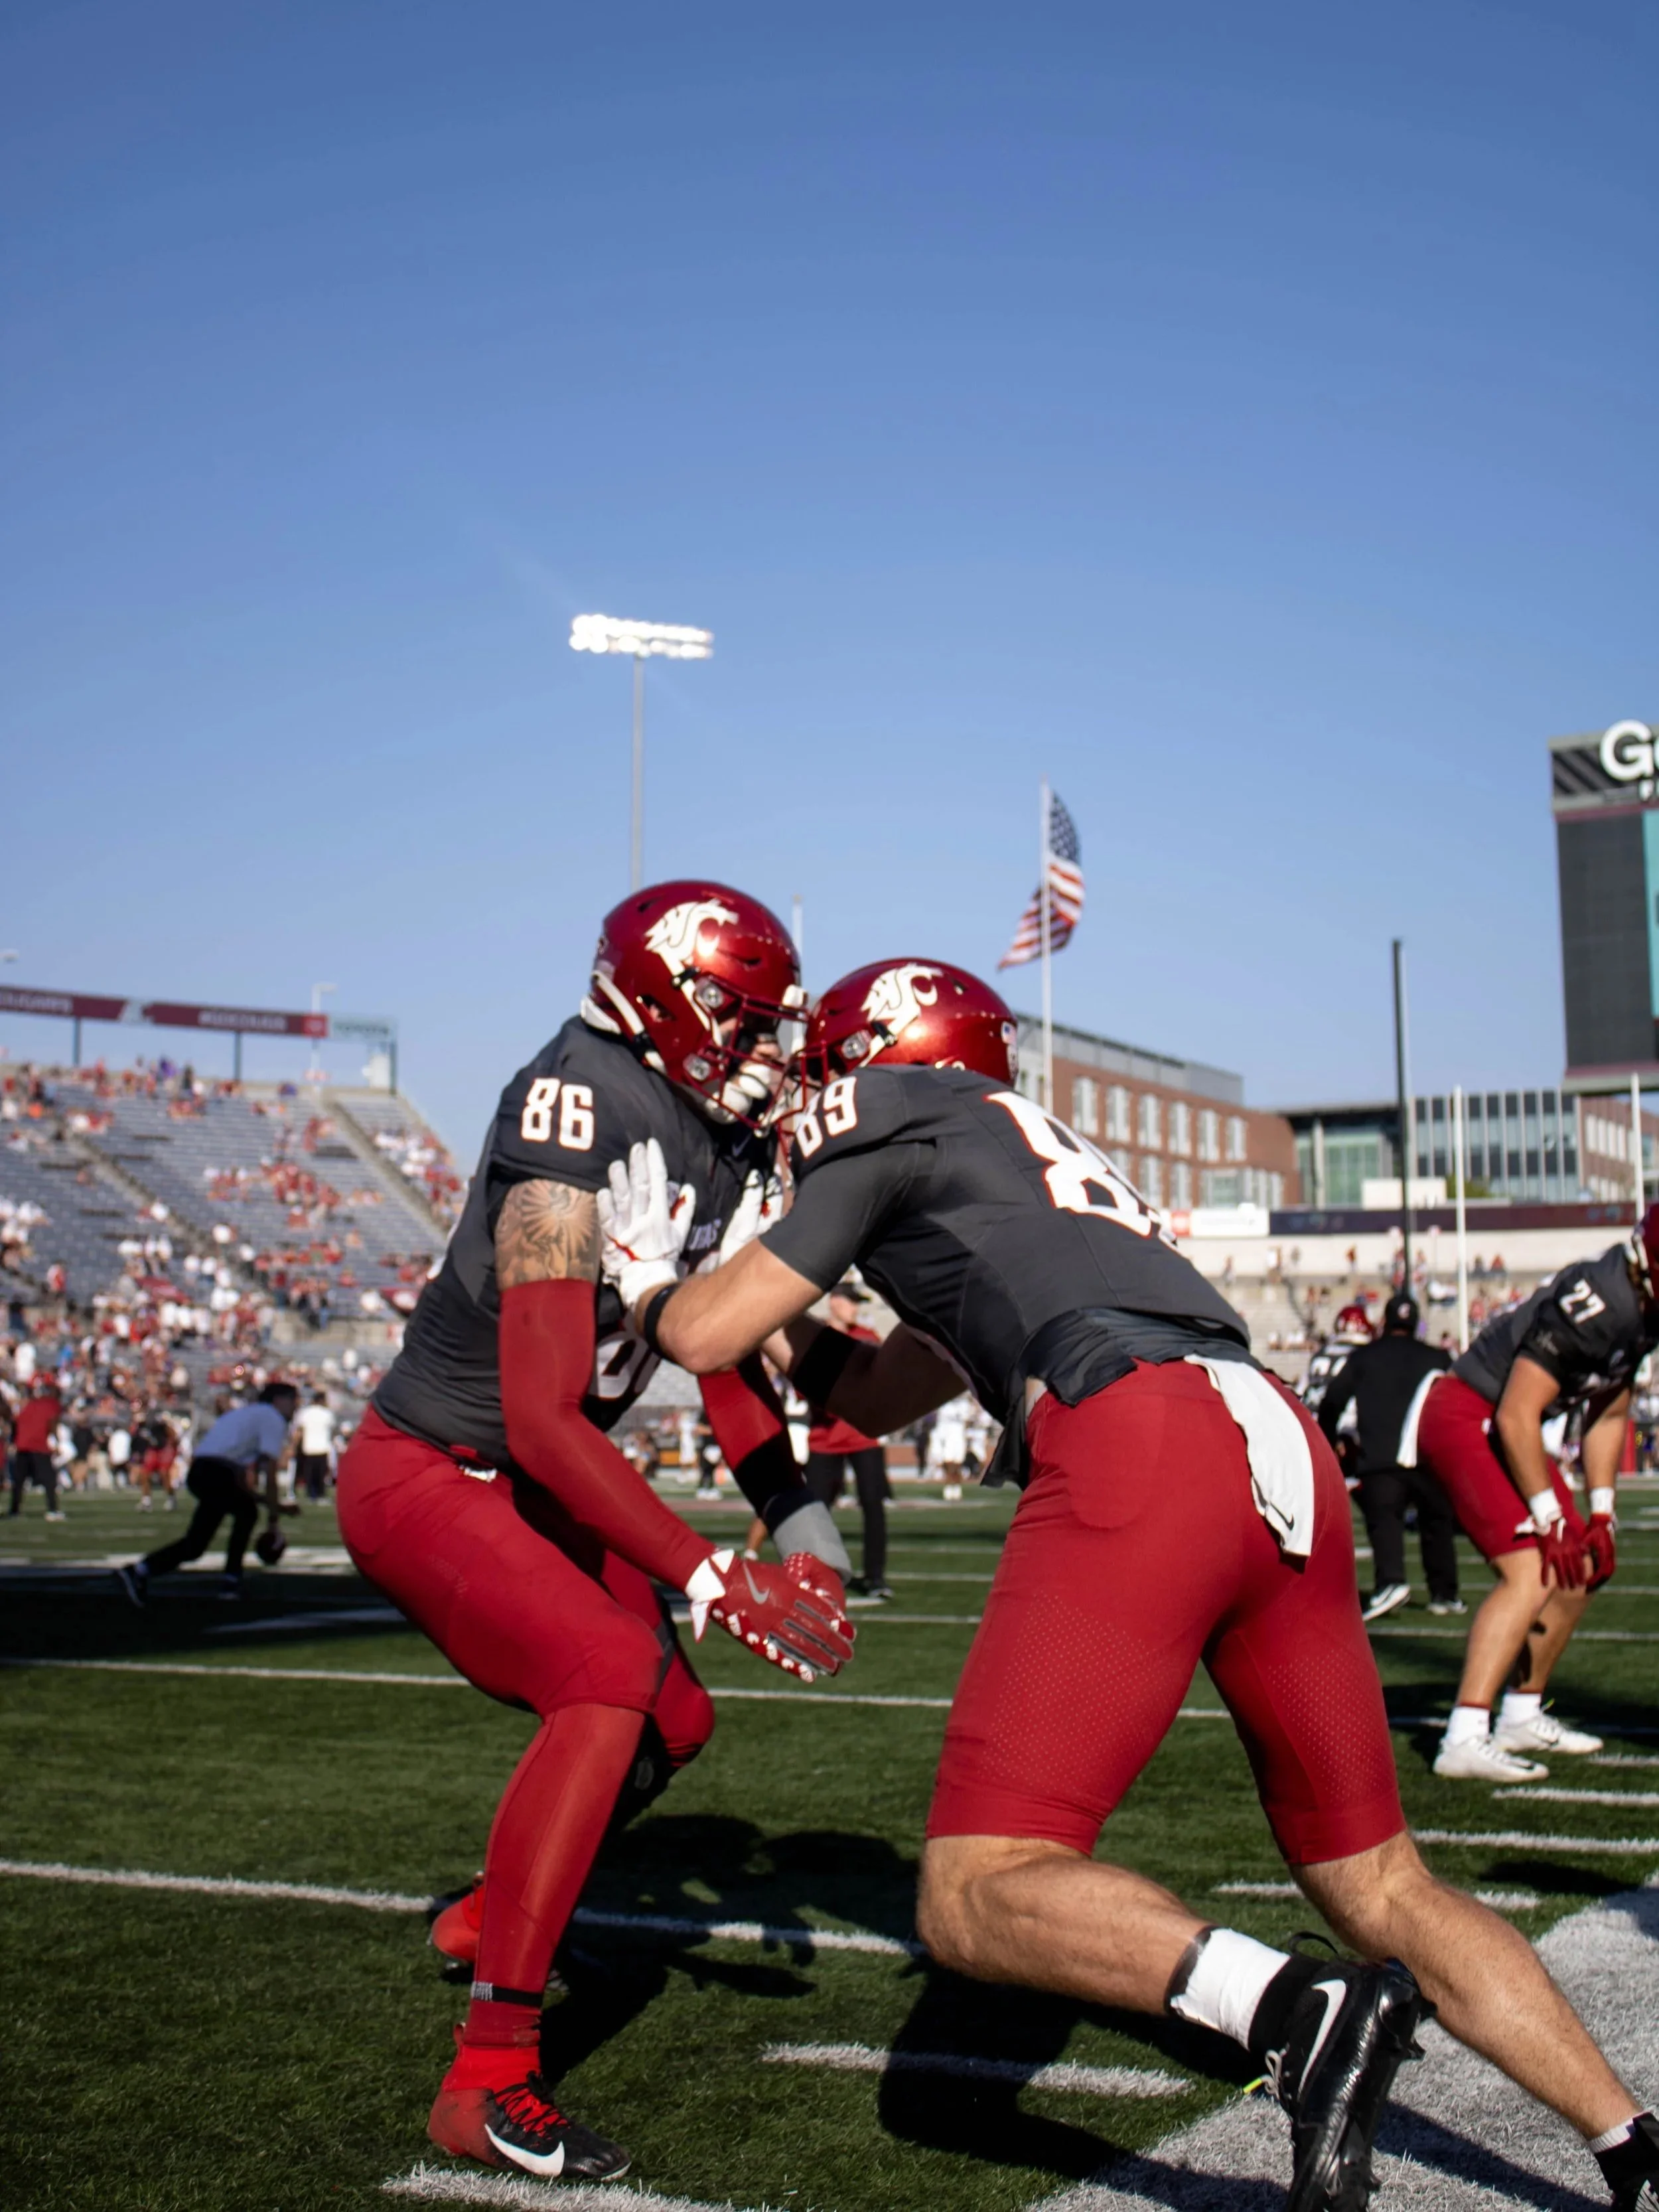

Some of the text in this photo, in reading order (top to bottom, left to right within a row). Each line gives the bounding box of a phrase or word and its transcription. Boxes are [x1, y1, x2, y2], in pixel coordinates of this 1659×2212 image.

[1599, 719, 1658, 781] G
[521, 1076, 595, 1151] 86
[796, 1075, 858, 1159] 89
[1559, 1278, 1606, 1325] 27
